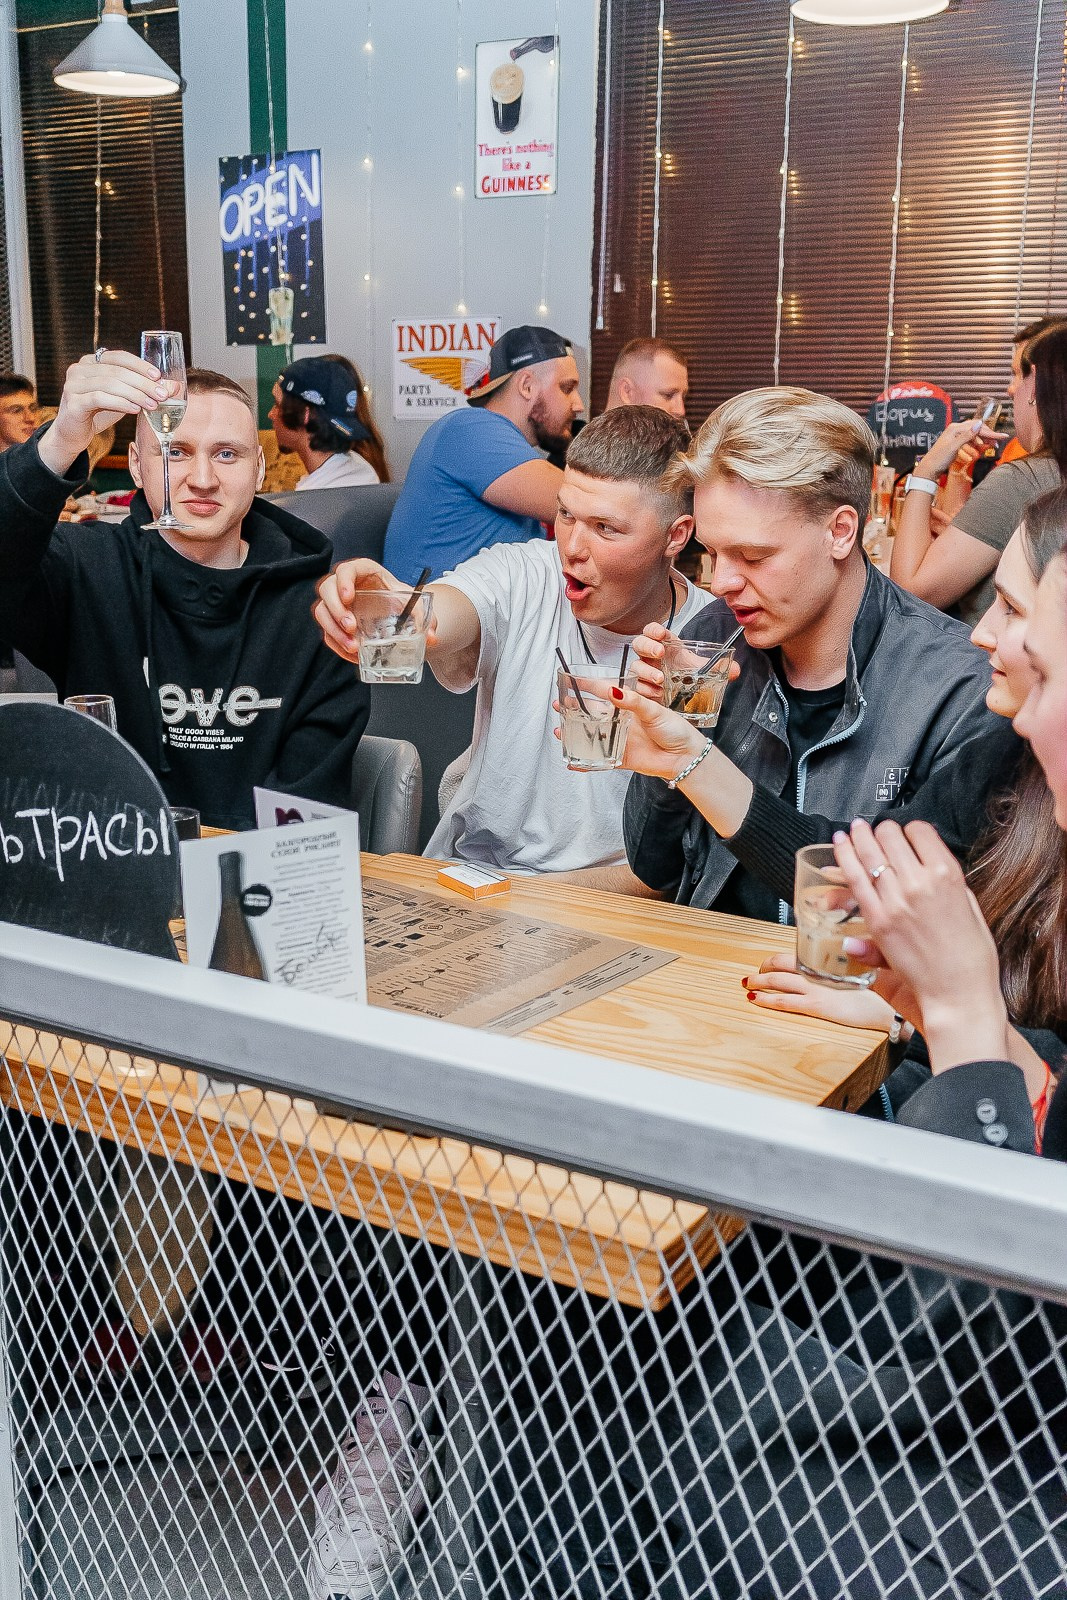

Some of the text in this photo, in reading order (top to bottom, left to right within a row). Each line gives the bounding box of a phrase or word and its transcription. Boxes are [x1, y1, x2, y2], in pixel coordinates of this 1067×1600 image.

[525, 161, 531, 169] a
[481, 174, 550, 193] GUINNESS
[220, 153, 320, 242] OPEN
[397, 322, 496, 351] INDIAN
[399, 385, 431, 395] PARTS
[417, 397, 456, 406] SERVICE
[168, 726, 184, 734] ONLY
